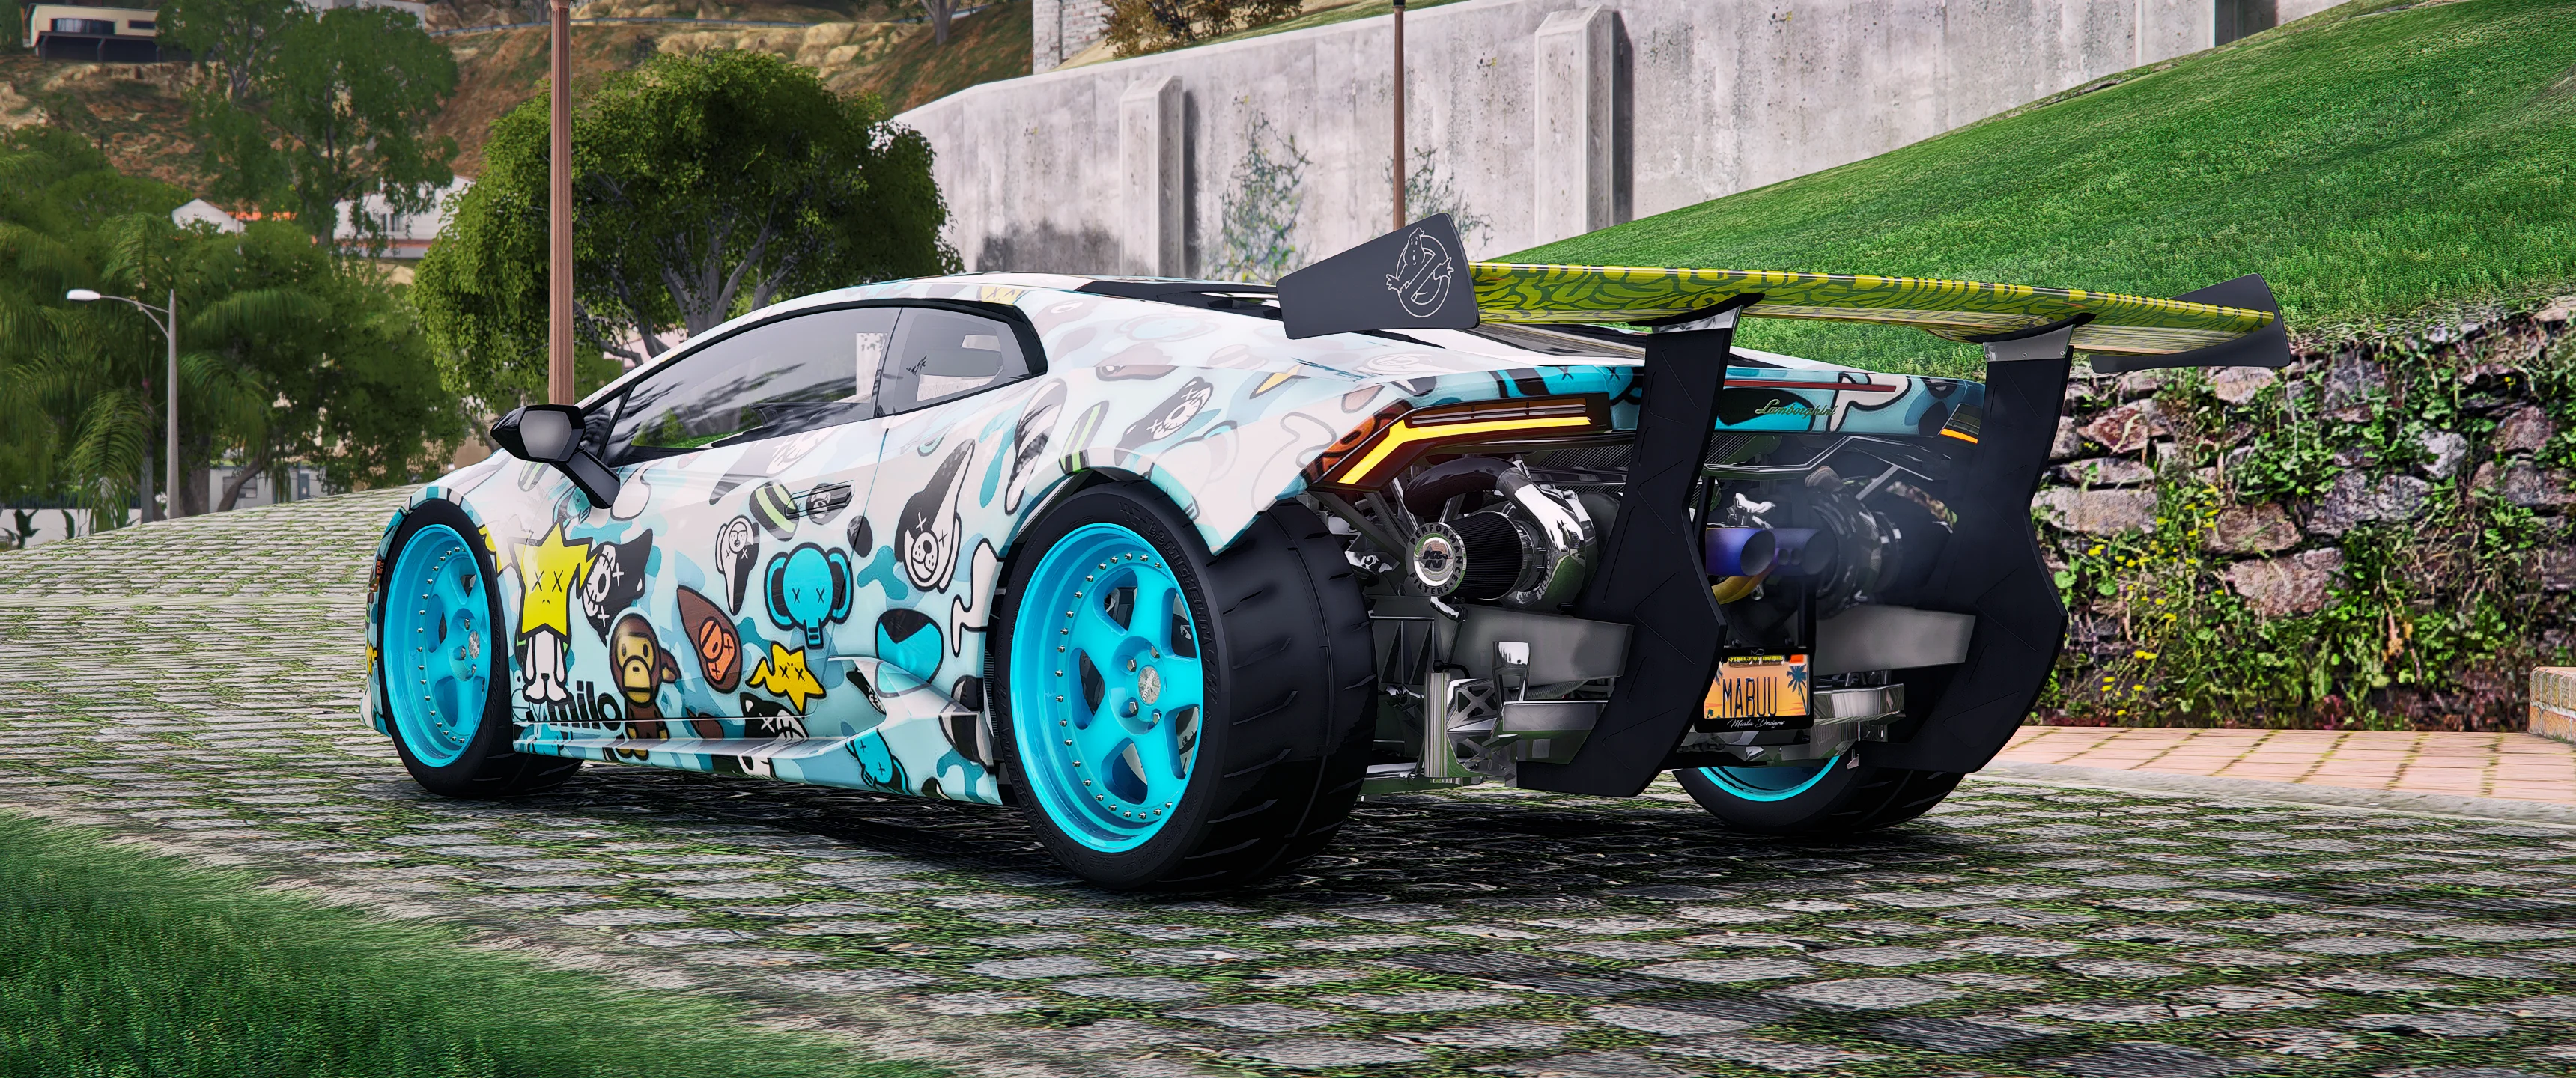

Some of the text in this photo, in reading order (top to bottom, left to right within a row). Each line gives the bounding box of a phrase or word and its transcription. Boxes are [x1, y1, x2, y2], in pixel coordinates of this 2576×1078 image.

[1755, 398, 1838, 419] Lamborghini
[1410, 525, 1462, 582] PERFORMANCE
[1164, 542, 1211, 642] MICHELIN
[1410, 573, 1450, 594] FILTERS
[1722, 676, 1777, 718] MABUU
